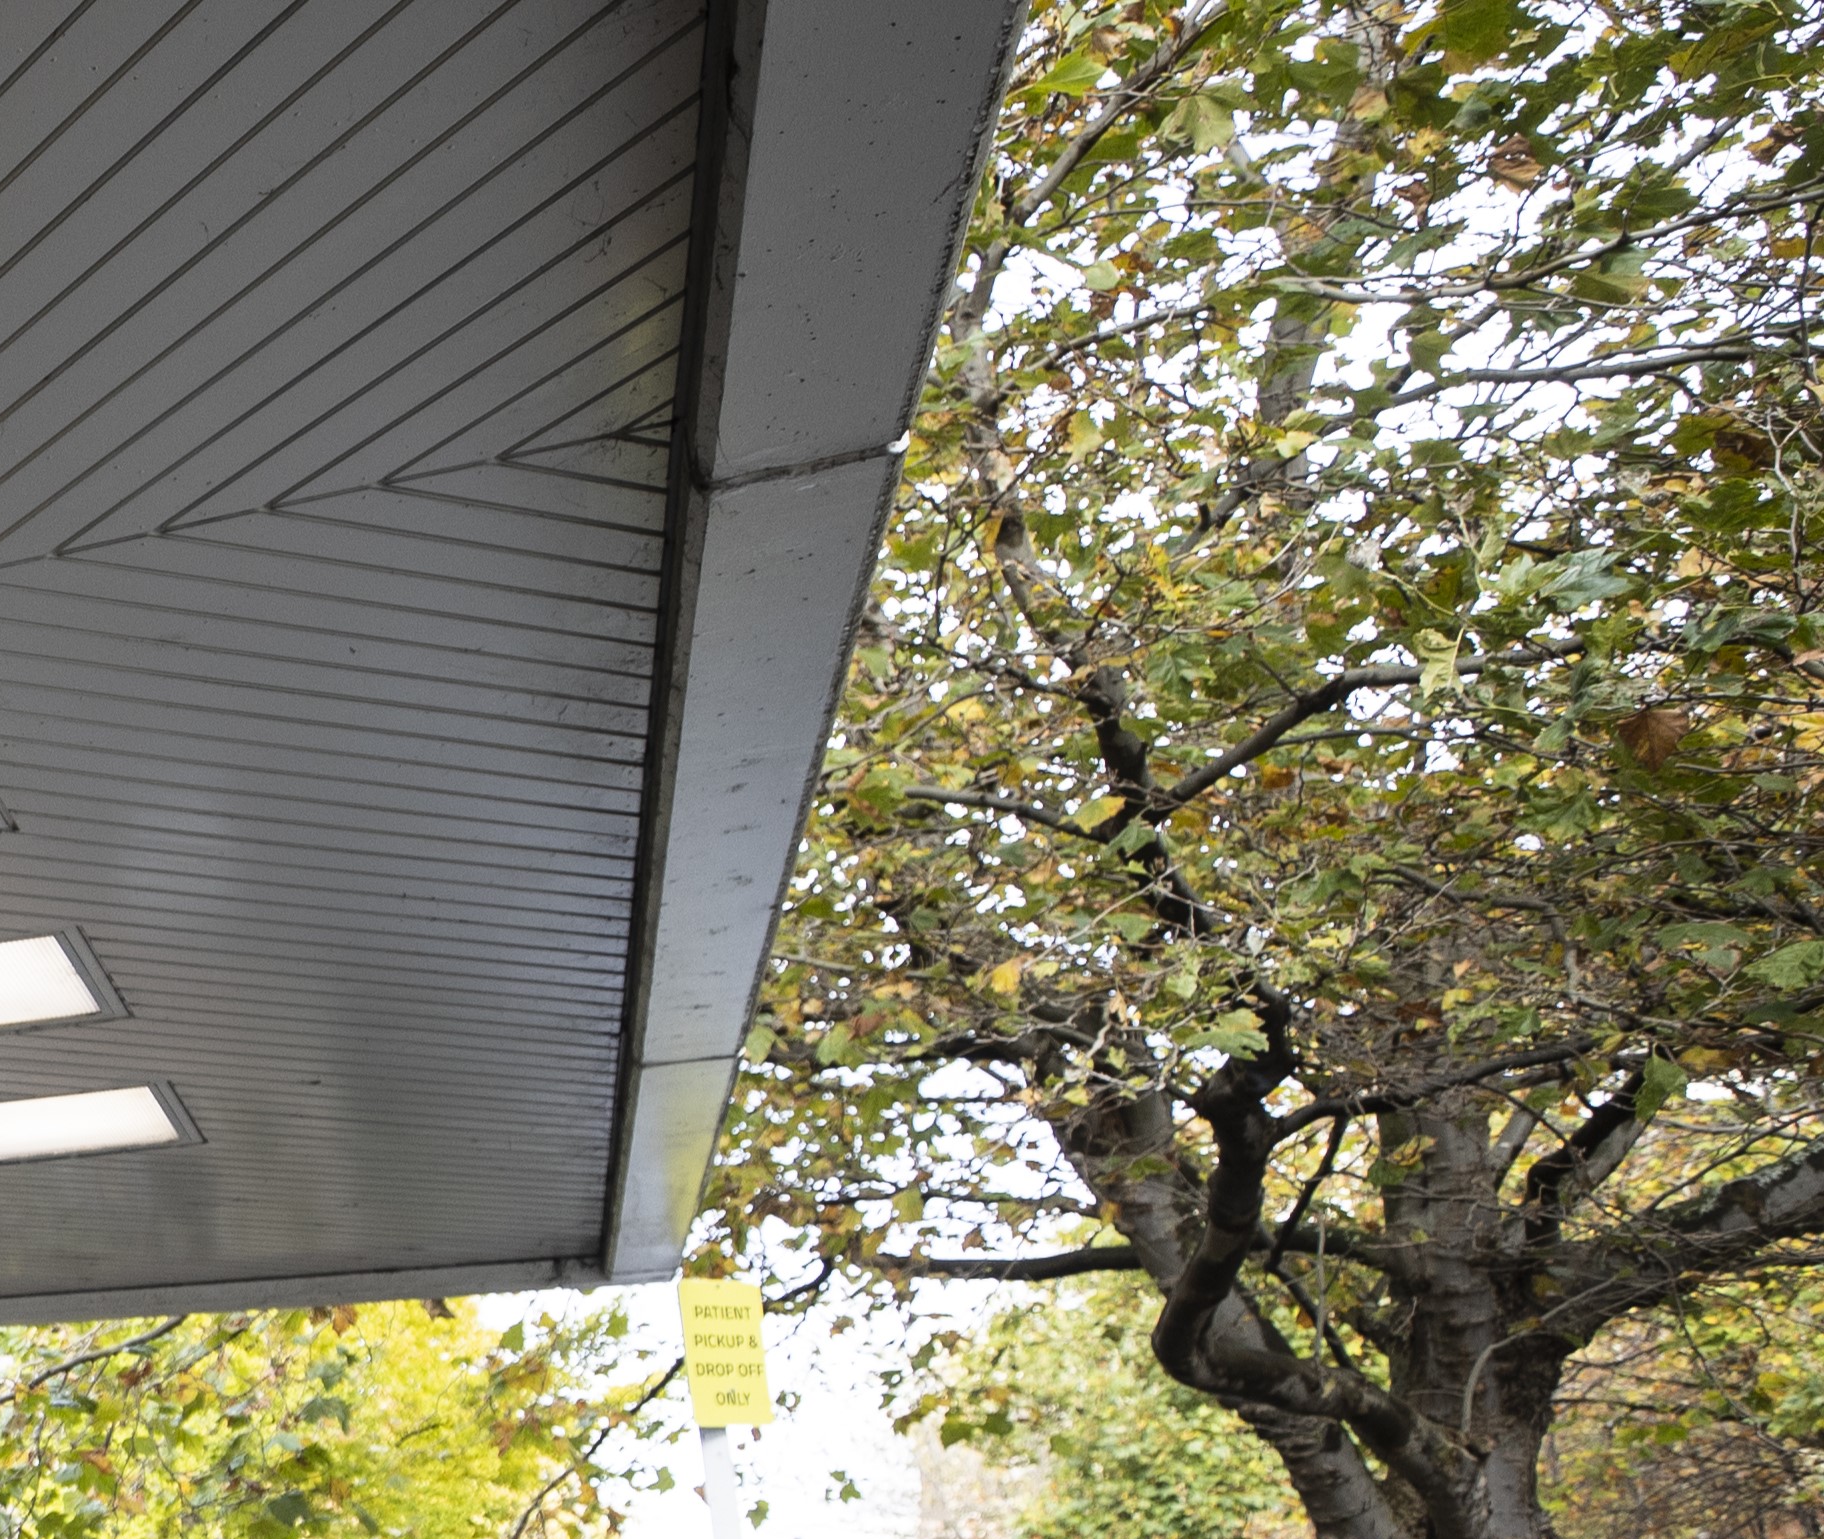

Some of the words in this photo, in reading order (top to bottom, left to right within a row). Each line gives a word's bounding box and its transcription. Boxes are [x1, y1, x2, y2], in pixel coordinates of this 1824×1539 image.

[694, 1305, 751, 1320] PATIENT
[694, 1334, 744, 1348] PICKUP
[749, 1335, 758, 1349] &
[696, 1363, 734, 1377] DROP
[738, 1363, 764, 1377] OFF
[716, 1391, 750, 1406] ONLY
